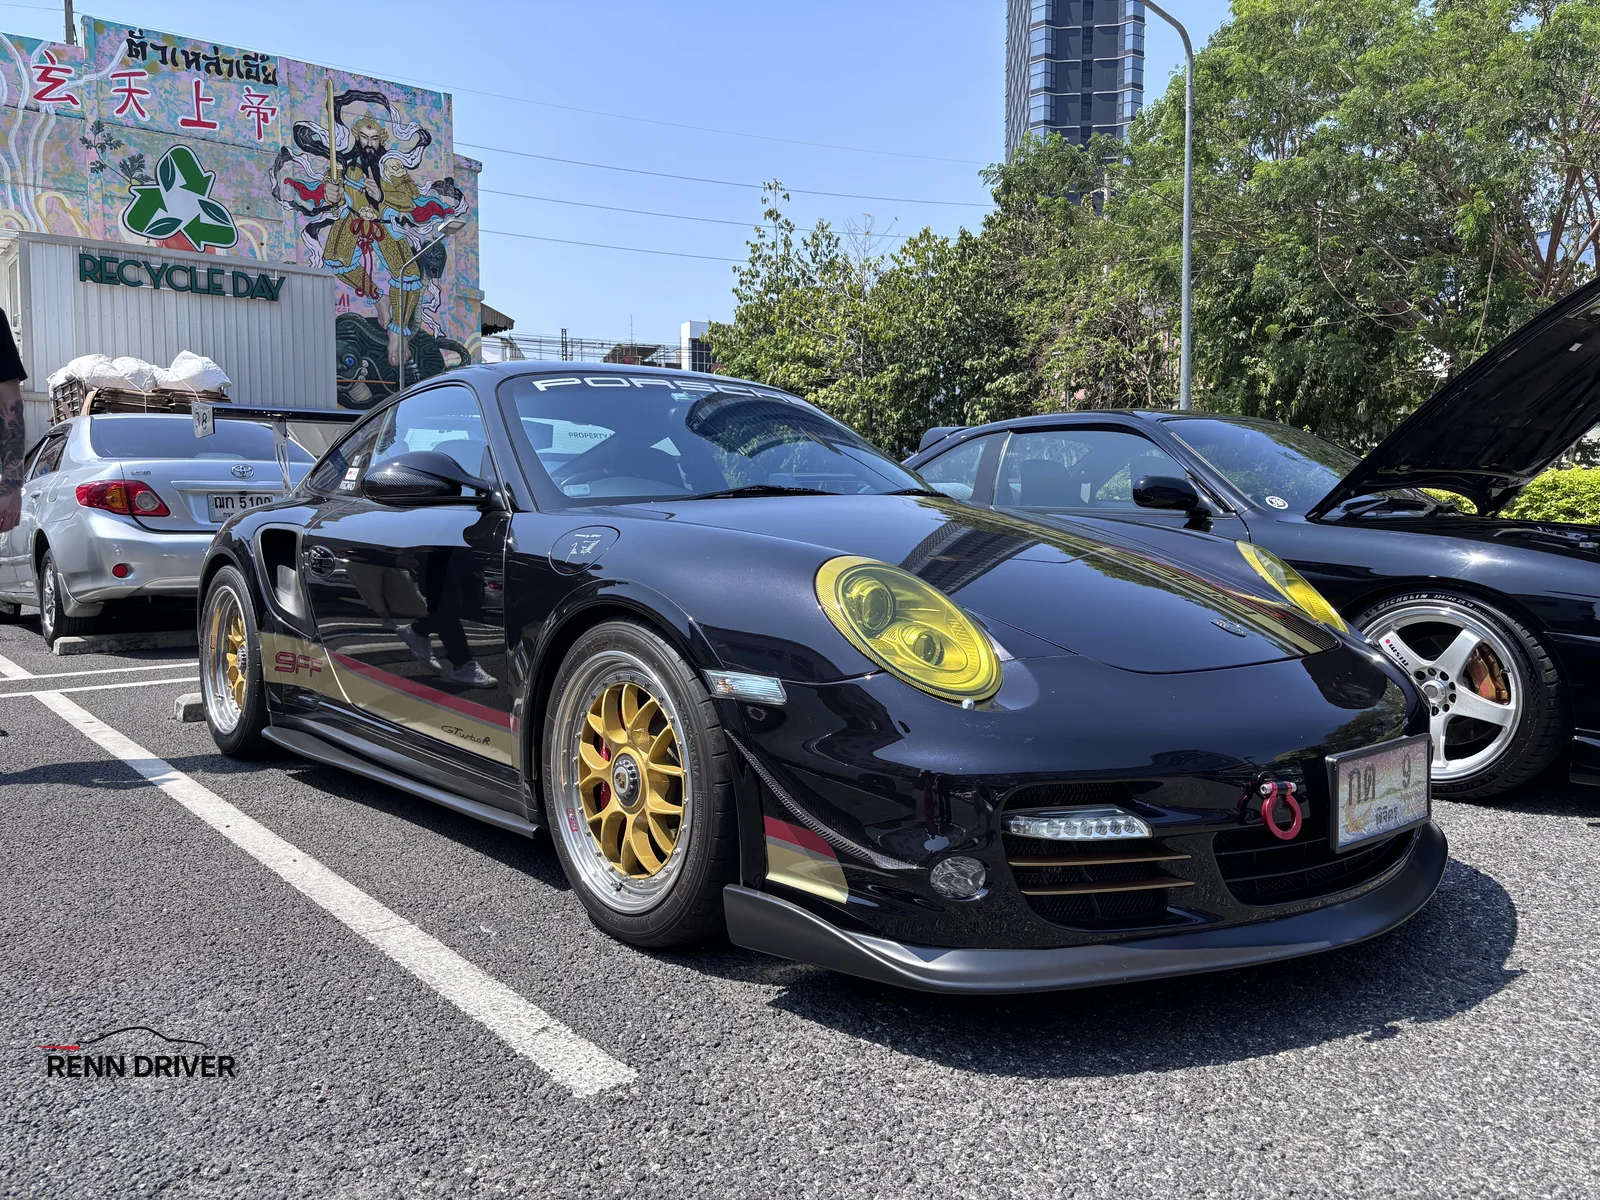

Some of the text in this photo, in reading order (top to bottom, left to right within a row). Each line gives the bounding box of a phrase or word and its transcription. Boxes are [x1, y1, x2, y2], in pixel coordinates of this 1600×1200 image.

[32, 49, 277, 141] 玄天上帝
[78, 253, 286, 302] RECYCLE DAY
[1377, 594, 1429, 610] MICHELIN
[1402, 753, 1412, 788] 9
[1431, 780, 1482, 793] MICHELI
